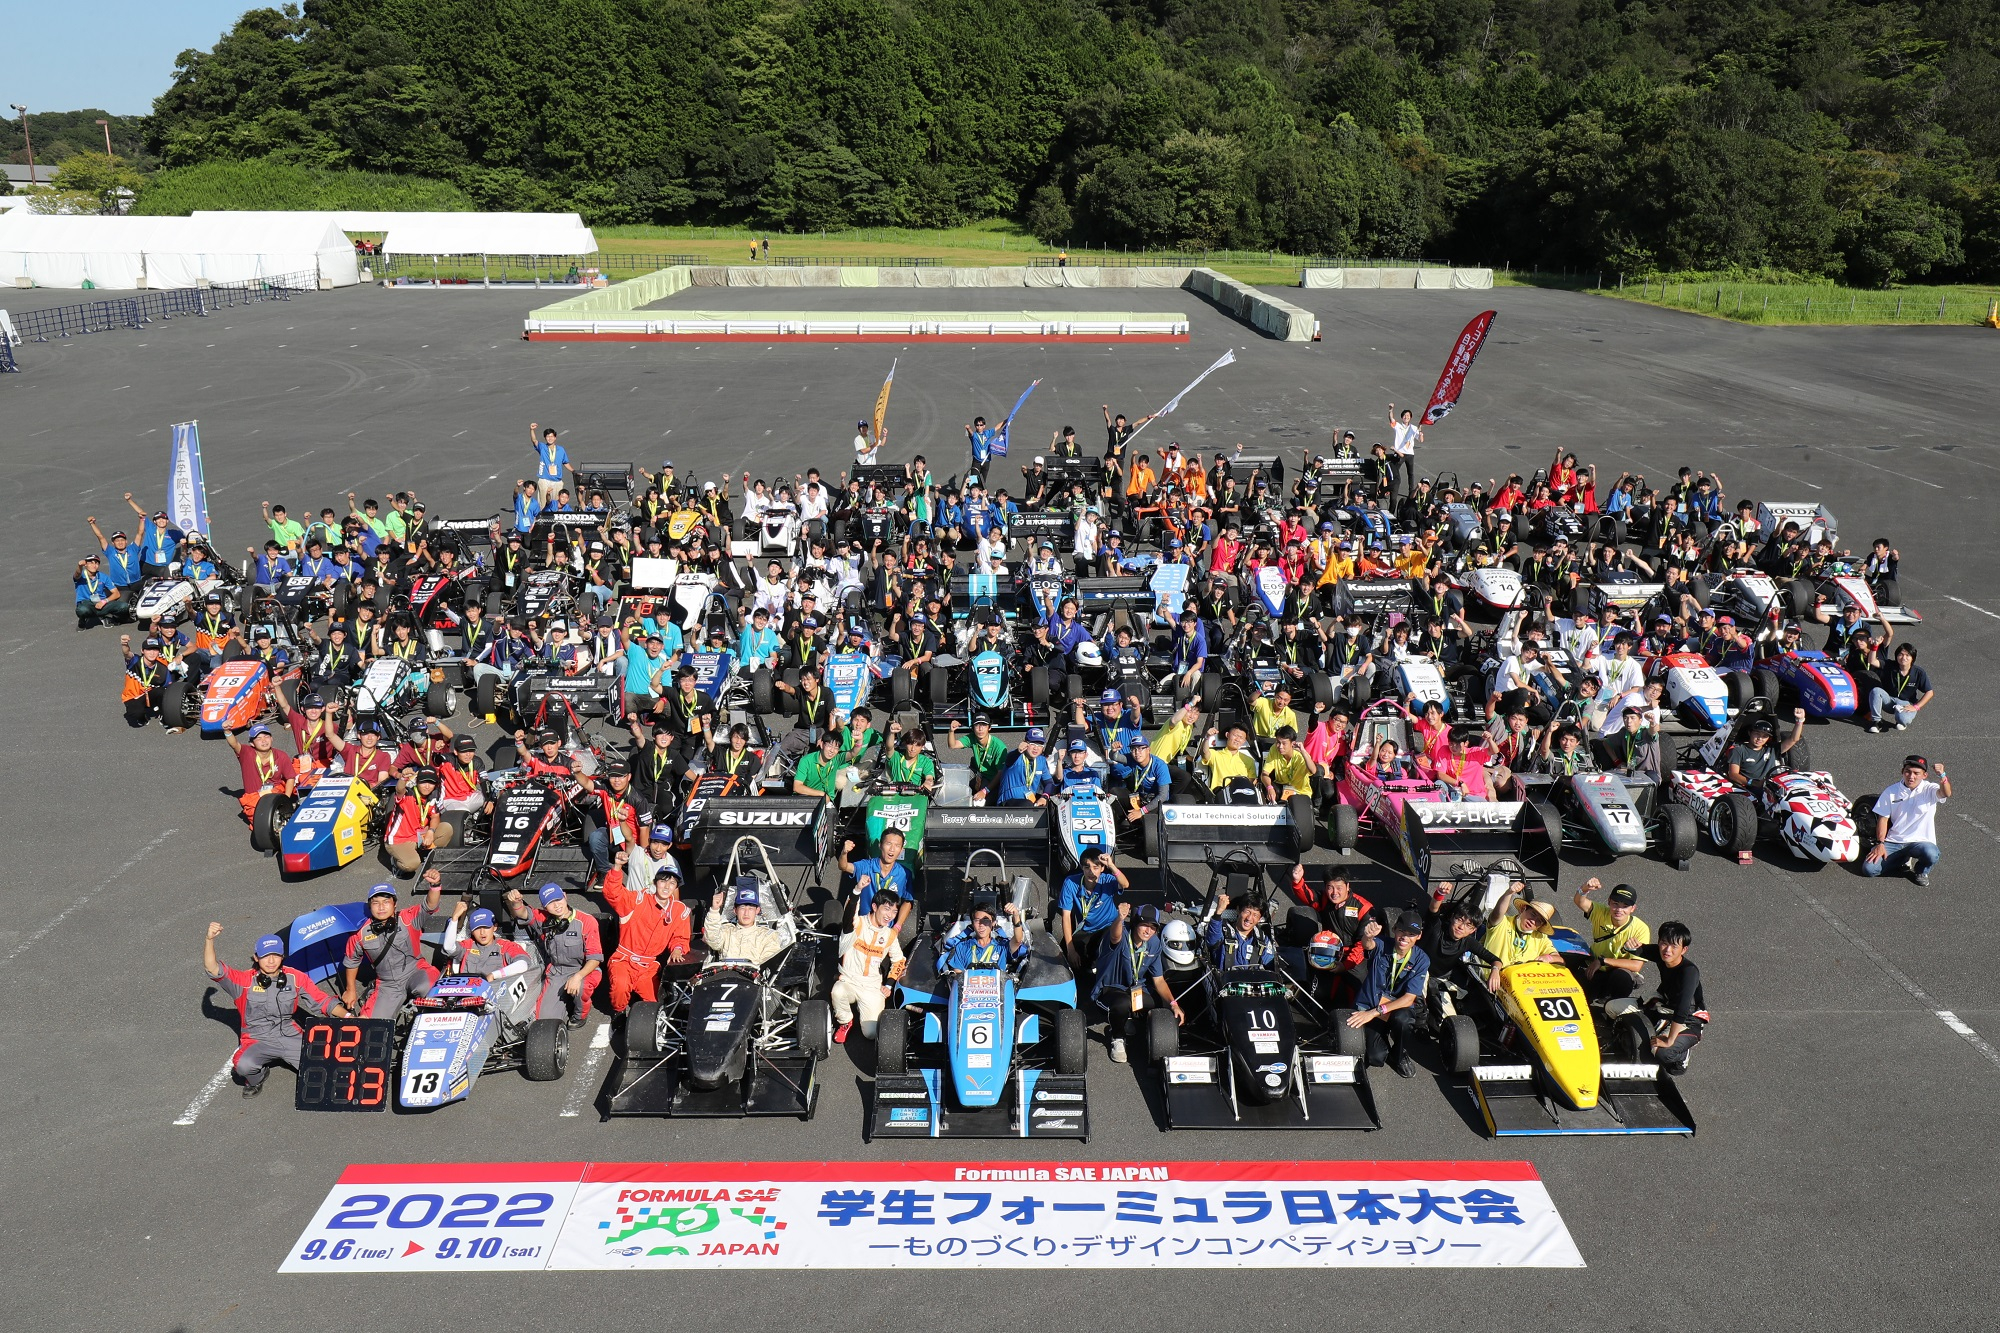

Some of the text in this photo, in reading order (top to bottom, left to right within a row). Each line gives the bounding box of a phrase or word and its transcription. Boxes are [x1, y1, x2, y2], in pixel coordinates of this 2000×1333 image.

[176, 450, 192, 516] 工学院大学
[553, 513, 598, 521] HONDA
[873, 525, 881, 533] 8
[289, 577, 311, 586] 55
[1032, 580, 1061, 589] E06
[1347, 582, 1412, 591] Kawasaki
[837, 668, 854, 676] 12
[1688, 670, 1709, 680] 29
[221, 677, 240, 686] 18
[551, 678, 595, 686] Kawasaki
[610, 684, 618, 704] 16
[1419, 688, 1441, 700] 15
[691, 800, 703, 810] 2
[1691, 793, 1706, 814] E08
[1807, 801, 1838, 813] E08
[300, 809, 328, 821] 35
[719, 811, 812, 825] SUZUKI
[942, 813, 1034, 825] Toray Carbon Magic
[1182, 812, 1286, 820] Total Technical Solutions
[1436, 808, 1516, 825] スチロ化学
[1607, 811, 1631, 824] 17
[504, 816, 529, 829] 16
[1073, 818, 1103, 830] 32
[1417, 847, 1429, 874] 30
[306, 915, 337, 932] YAMAHA
[720, 984, 738, 1000] 7
[1540, 999, 1574, 1018] 30
[1247, 1009, 1276, 1029] 10
[971, 1026, 987, 1044] 6
[309, 1025, 362, 1062] 72
[346, 1067, 385, 1106] 13
[411, 1073, 440, 1094] 13
[954, 1167, 1169, 1182] Formula SAE JAPAN
[617, 1187, 782, 1202] FORMULA SAE
[325, 1192, 554, 1229] 2022
[817, 1188, 1525, 1227] 学生フォーミュラ日本大会
[300, 1237, 351, 1261] 9.6
[435, 1237, 502, 1260] 9.10
[697, 1243, 780, 1256] JAPAN
